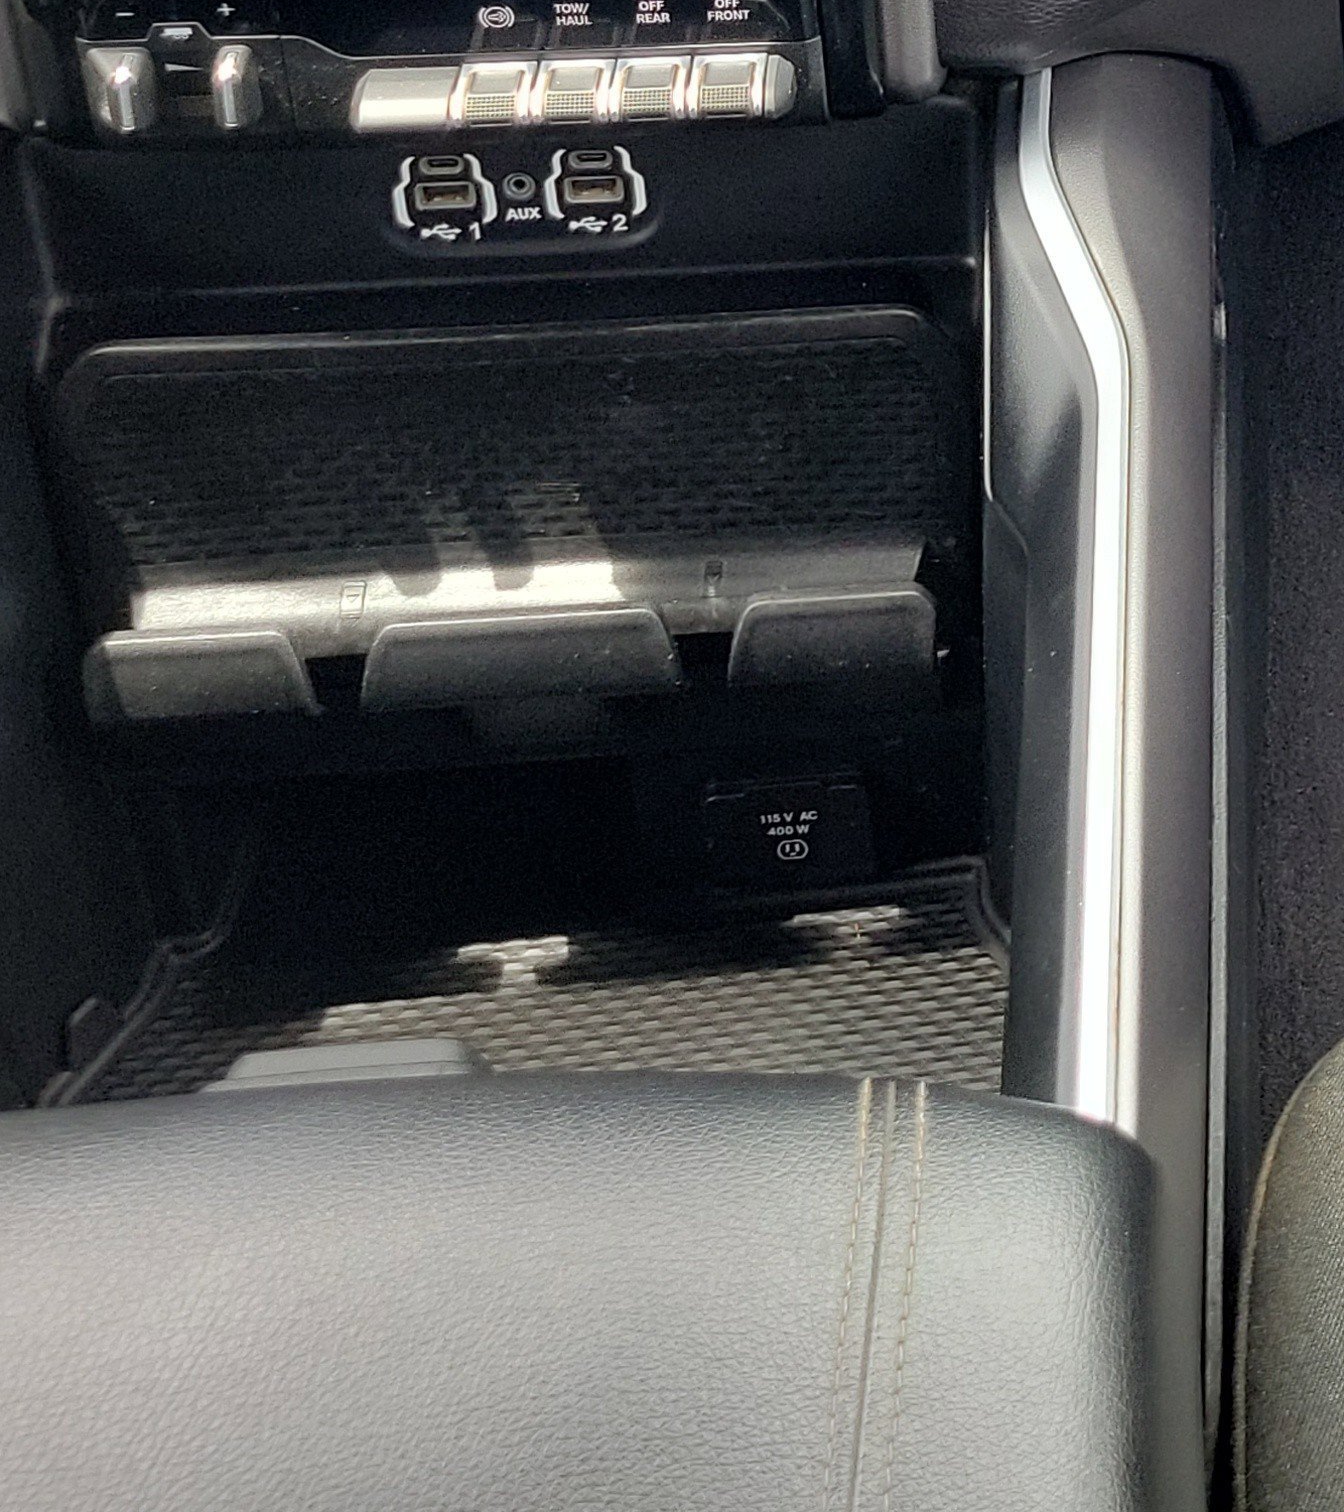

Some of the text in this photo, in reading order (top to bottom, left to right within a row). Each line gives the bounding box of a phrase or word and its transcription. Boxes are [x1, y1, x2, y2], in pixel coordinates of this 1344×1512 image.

[638, 0, 665, 11] OFF
[555, 15, 593, 27] HAUL
[635, 12, 671, 24] REAR
[706, 9, 751, 22] FRONT
[505, 206, 542, 222] AUX
[611, 213, 629, 232] 2
[469, 221, 482, 240] 1
[759, 810, 819, 825] 115 V AC
[766, 824, 811, 836] 400 W
